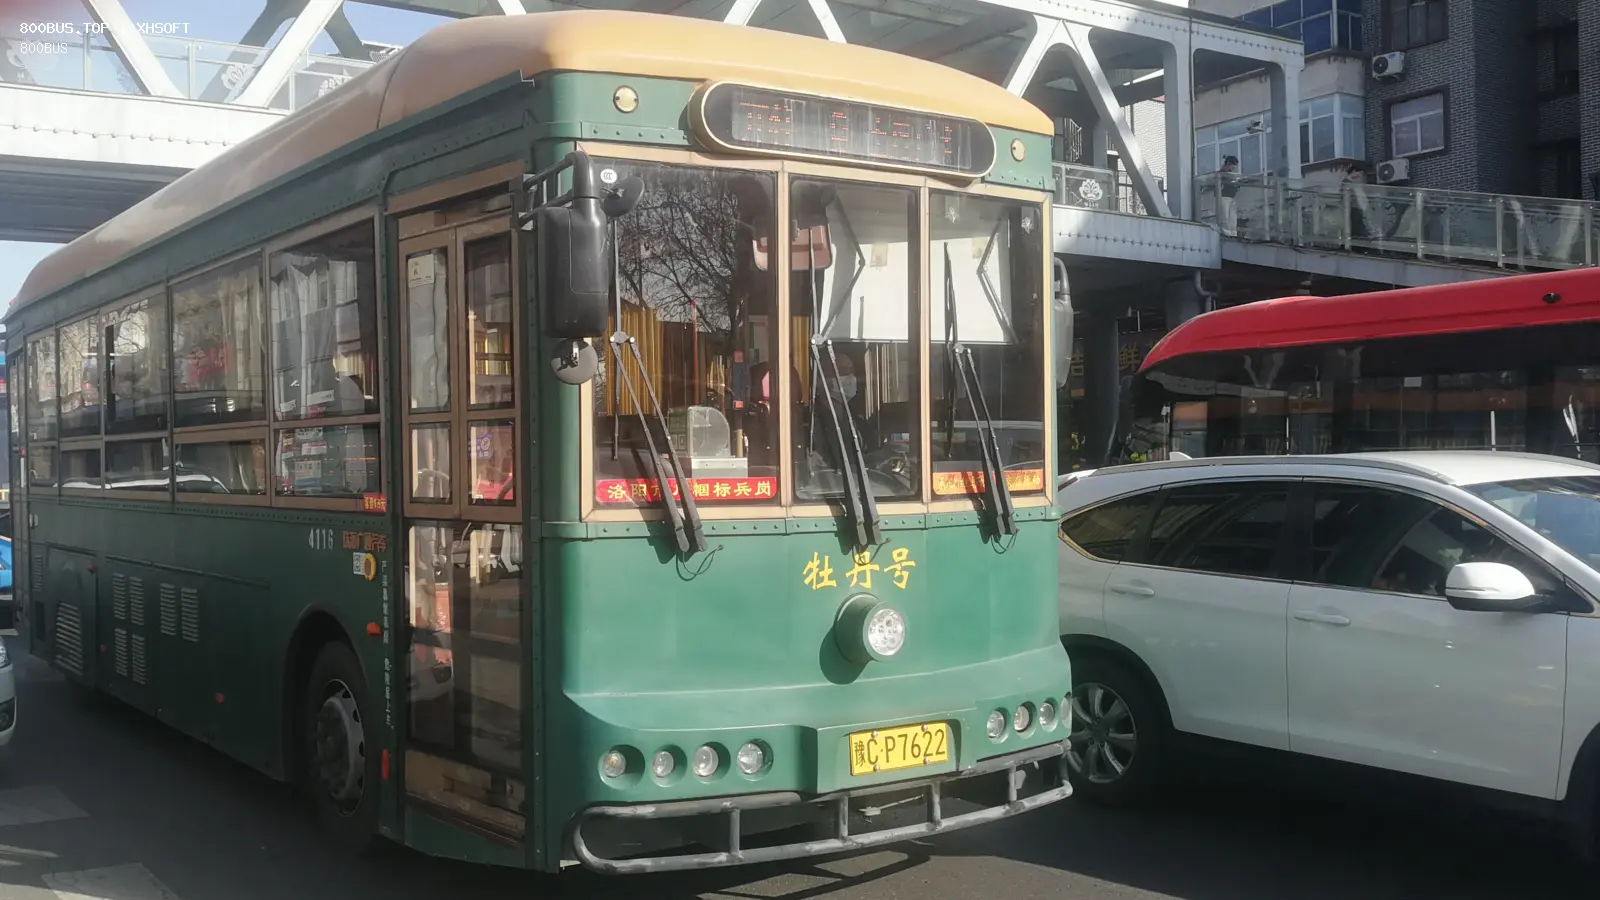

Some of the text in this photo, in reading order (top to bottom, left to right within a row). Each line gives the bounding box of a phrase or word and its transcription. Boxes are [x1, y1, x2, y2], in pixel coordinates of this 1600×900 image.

[308, 527, 334, 550] 4116
[803, 547, 916, 590] 牡丹号
